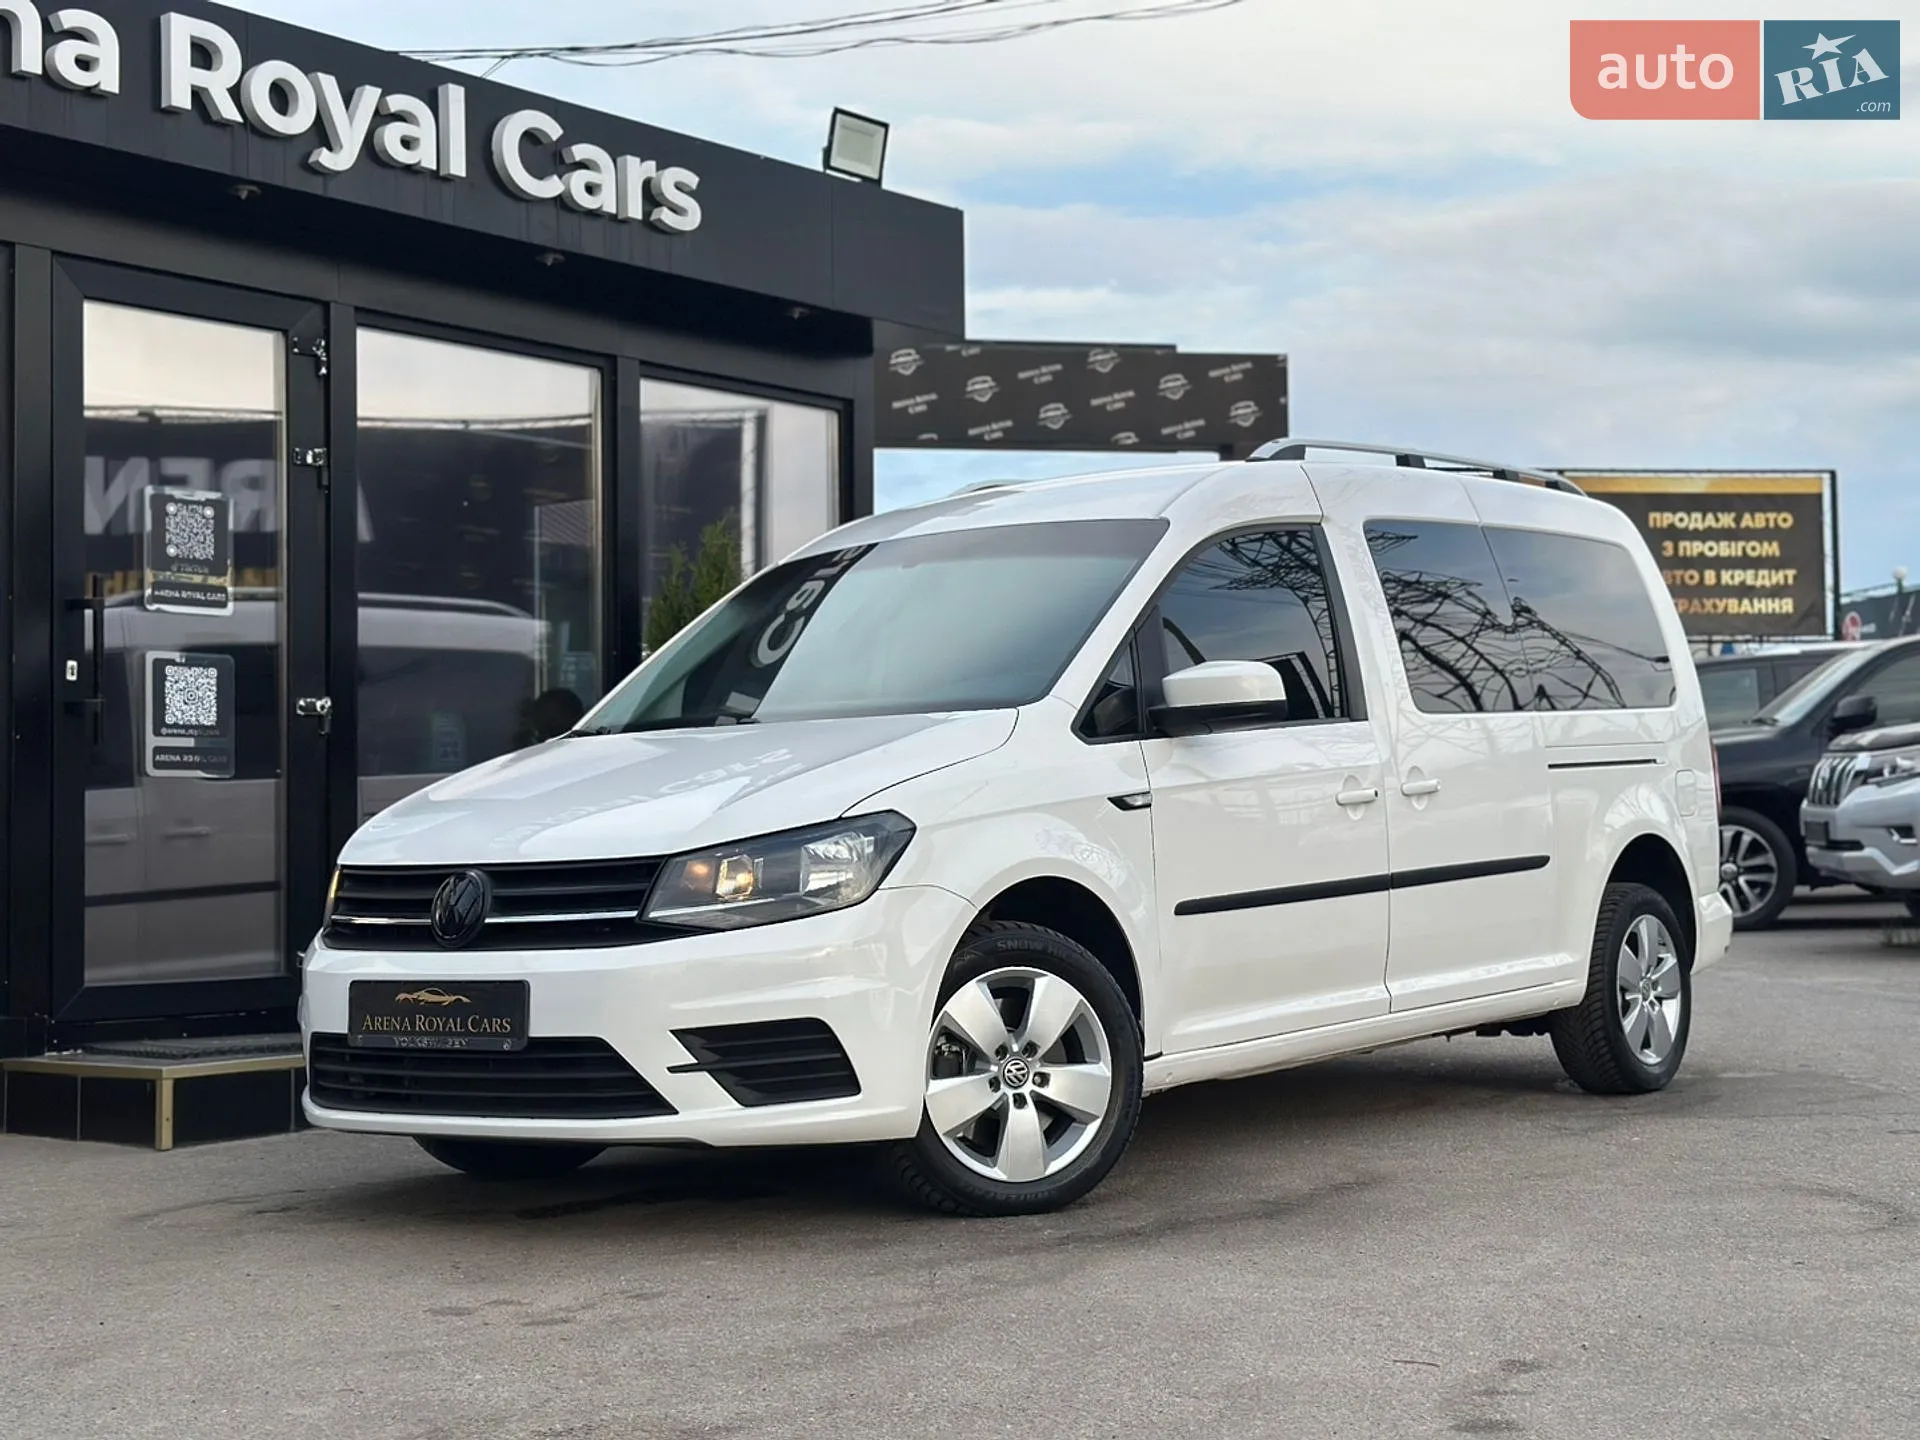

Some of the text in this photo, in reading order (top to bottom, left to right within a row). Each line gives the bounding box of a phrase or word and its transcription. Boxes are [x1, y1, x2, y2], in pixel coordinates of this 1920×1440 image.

[160, 12, 467, 179] Royal
[491, 109, 702, 234] Cars
[1648, 511, 1794, 531] ПРОДАЖ АВТО
[1661, 540, 1781, 557] З ПРОБІГОМ
[1661, 569, 1797, 588] ВТО В КРЕДИТ
[1676, 598, 1794, 614] РАХУВАННЯ
[362, 1013, 512, 1034] ARENA ROYAL CARS
